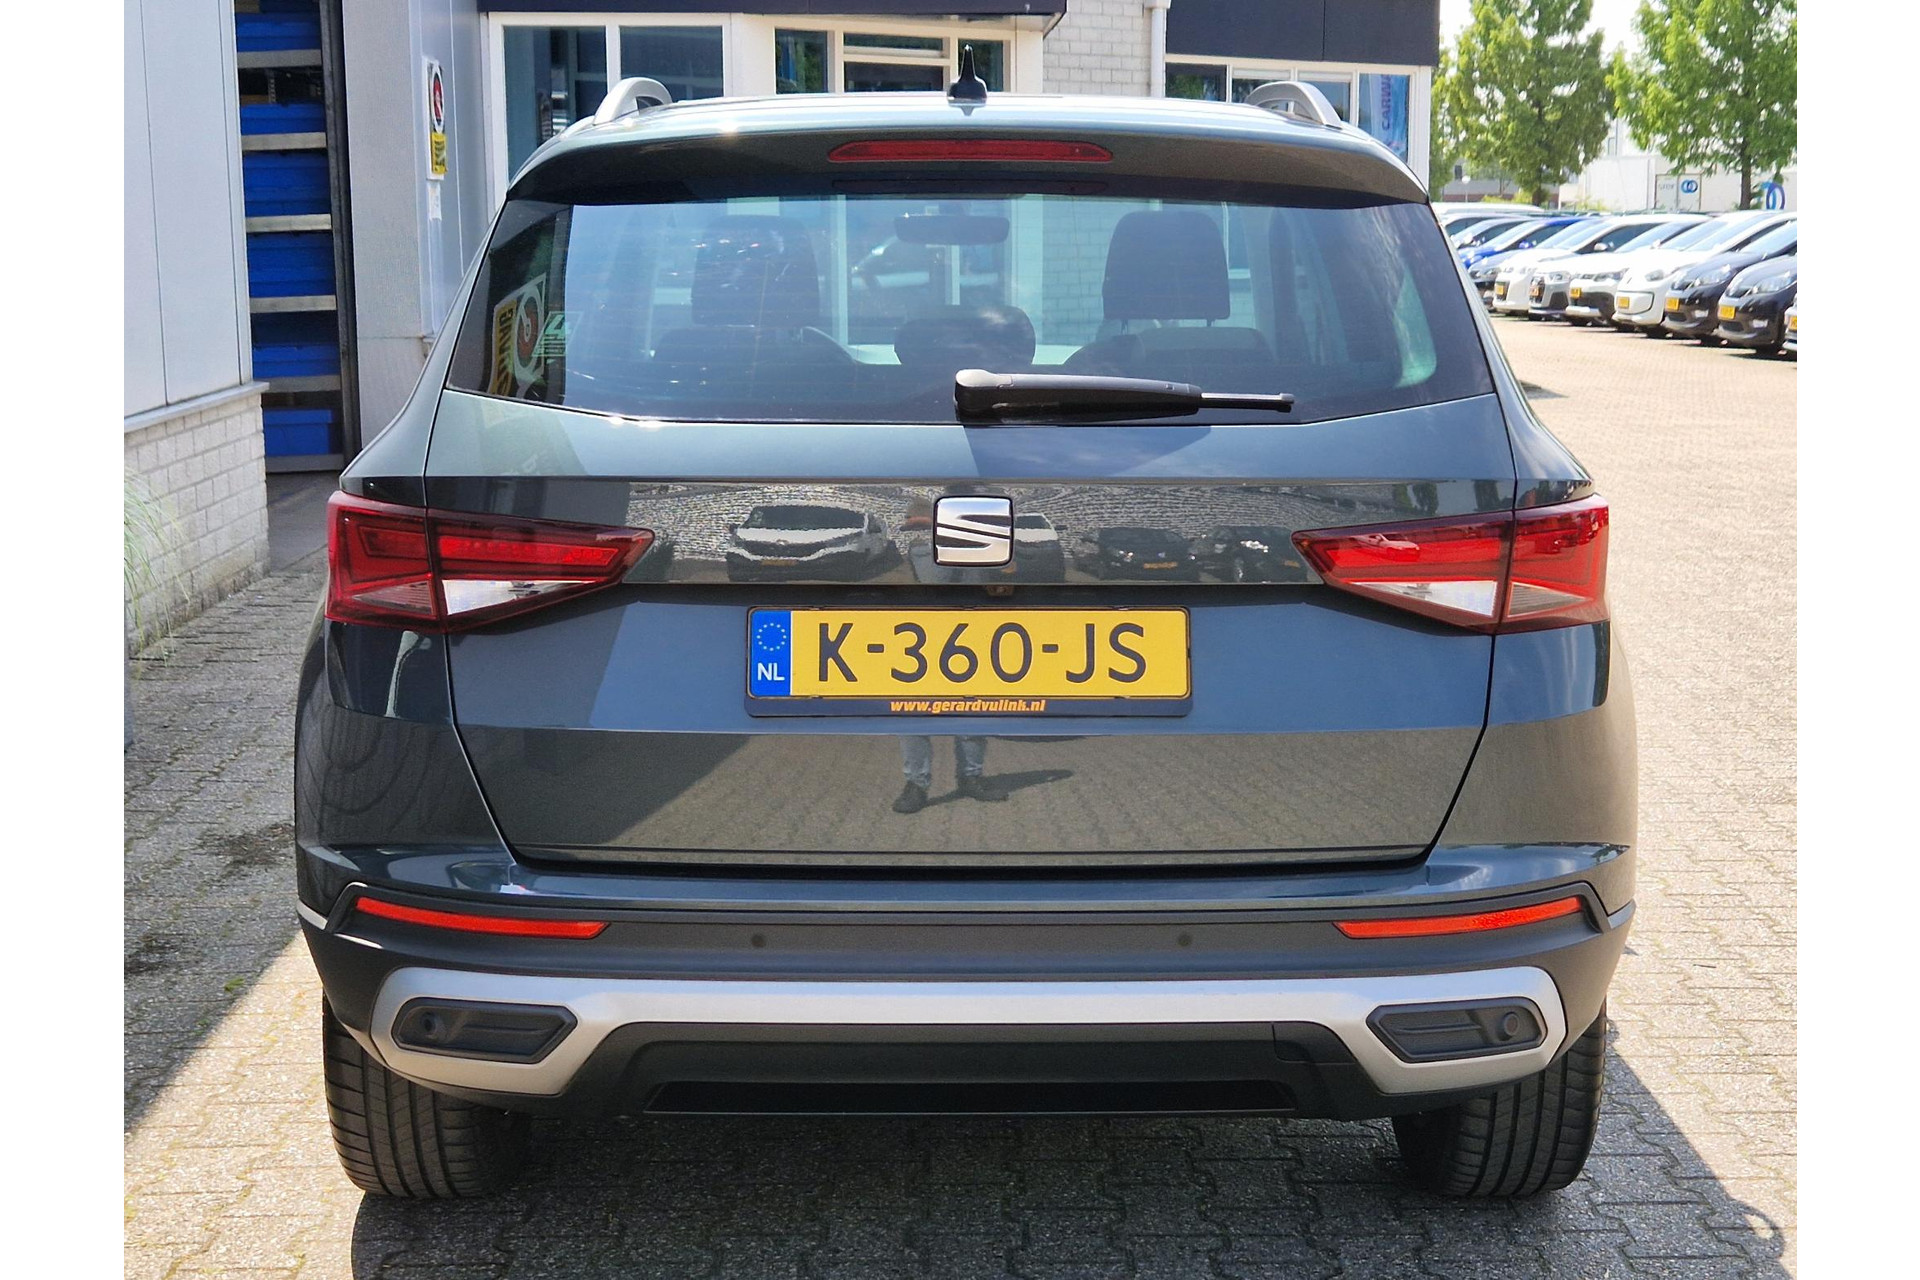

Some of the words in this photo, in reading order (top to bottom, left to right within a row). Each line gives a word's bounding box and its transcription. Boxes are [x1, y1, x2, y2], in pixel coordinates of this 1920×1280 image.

[818, 622, 1146, 683] K-360-JS
[757, 662, 785, 681] NL
[890, 700, 1046, 714] www.gerardvulink.nl
